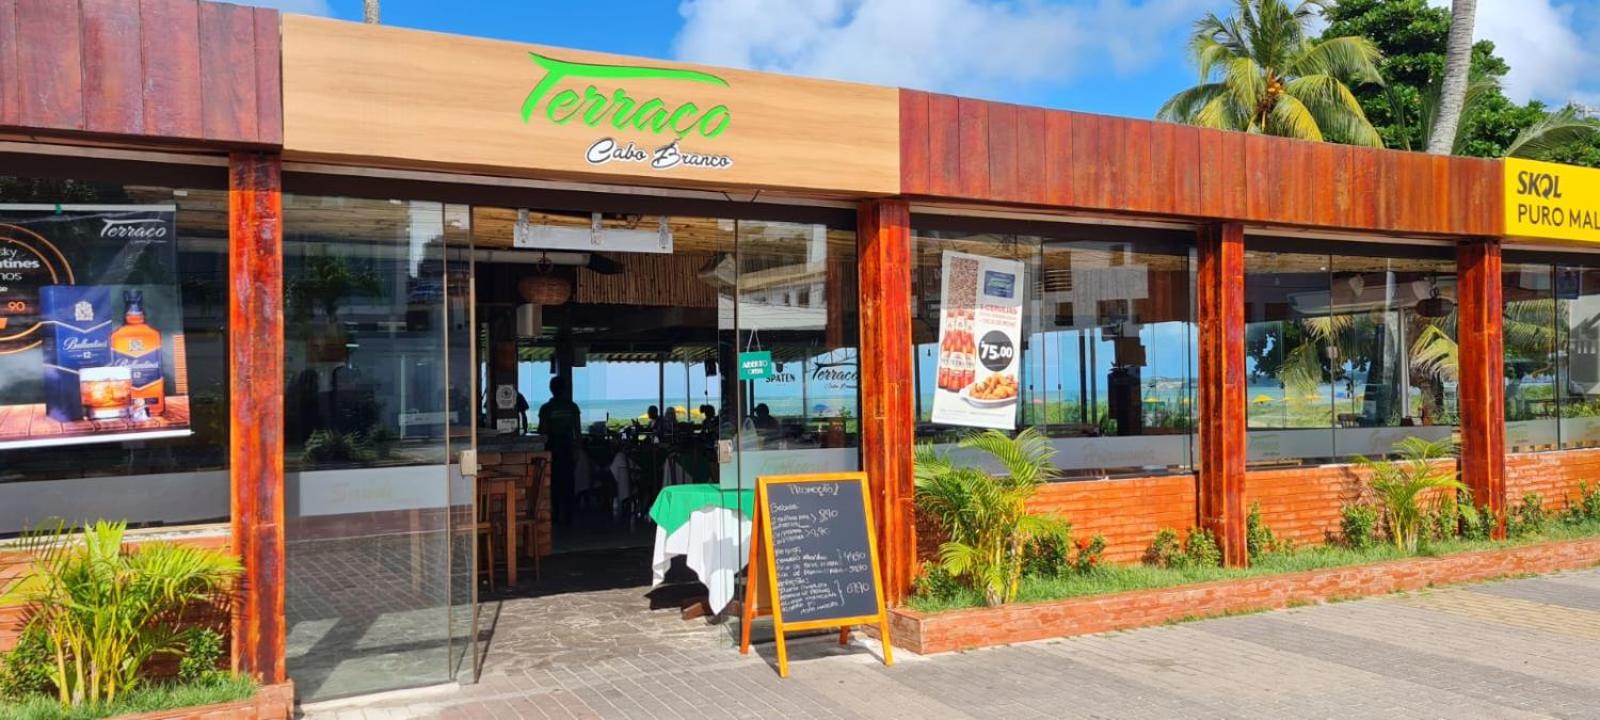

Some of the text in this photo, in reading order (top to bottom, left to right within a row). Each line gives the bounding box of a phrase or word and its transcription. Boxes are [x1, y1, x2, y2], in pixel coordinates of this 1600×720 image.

[585, 137, 733, 169] Cabo Branco
[1518, 203, 1564, 227] PURO
